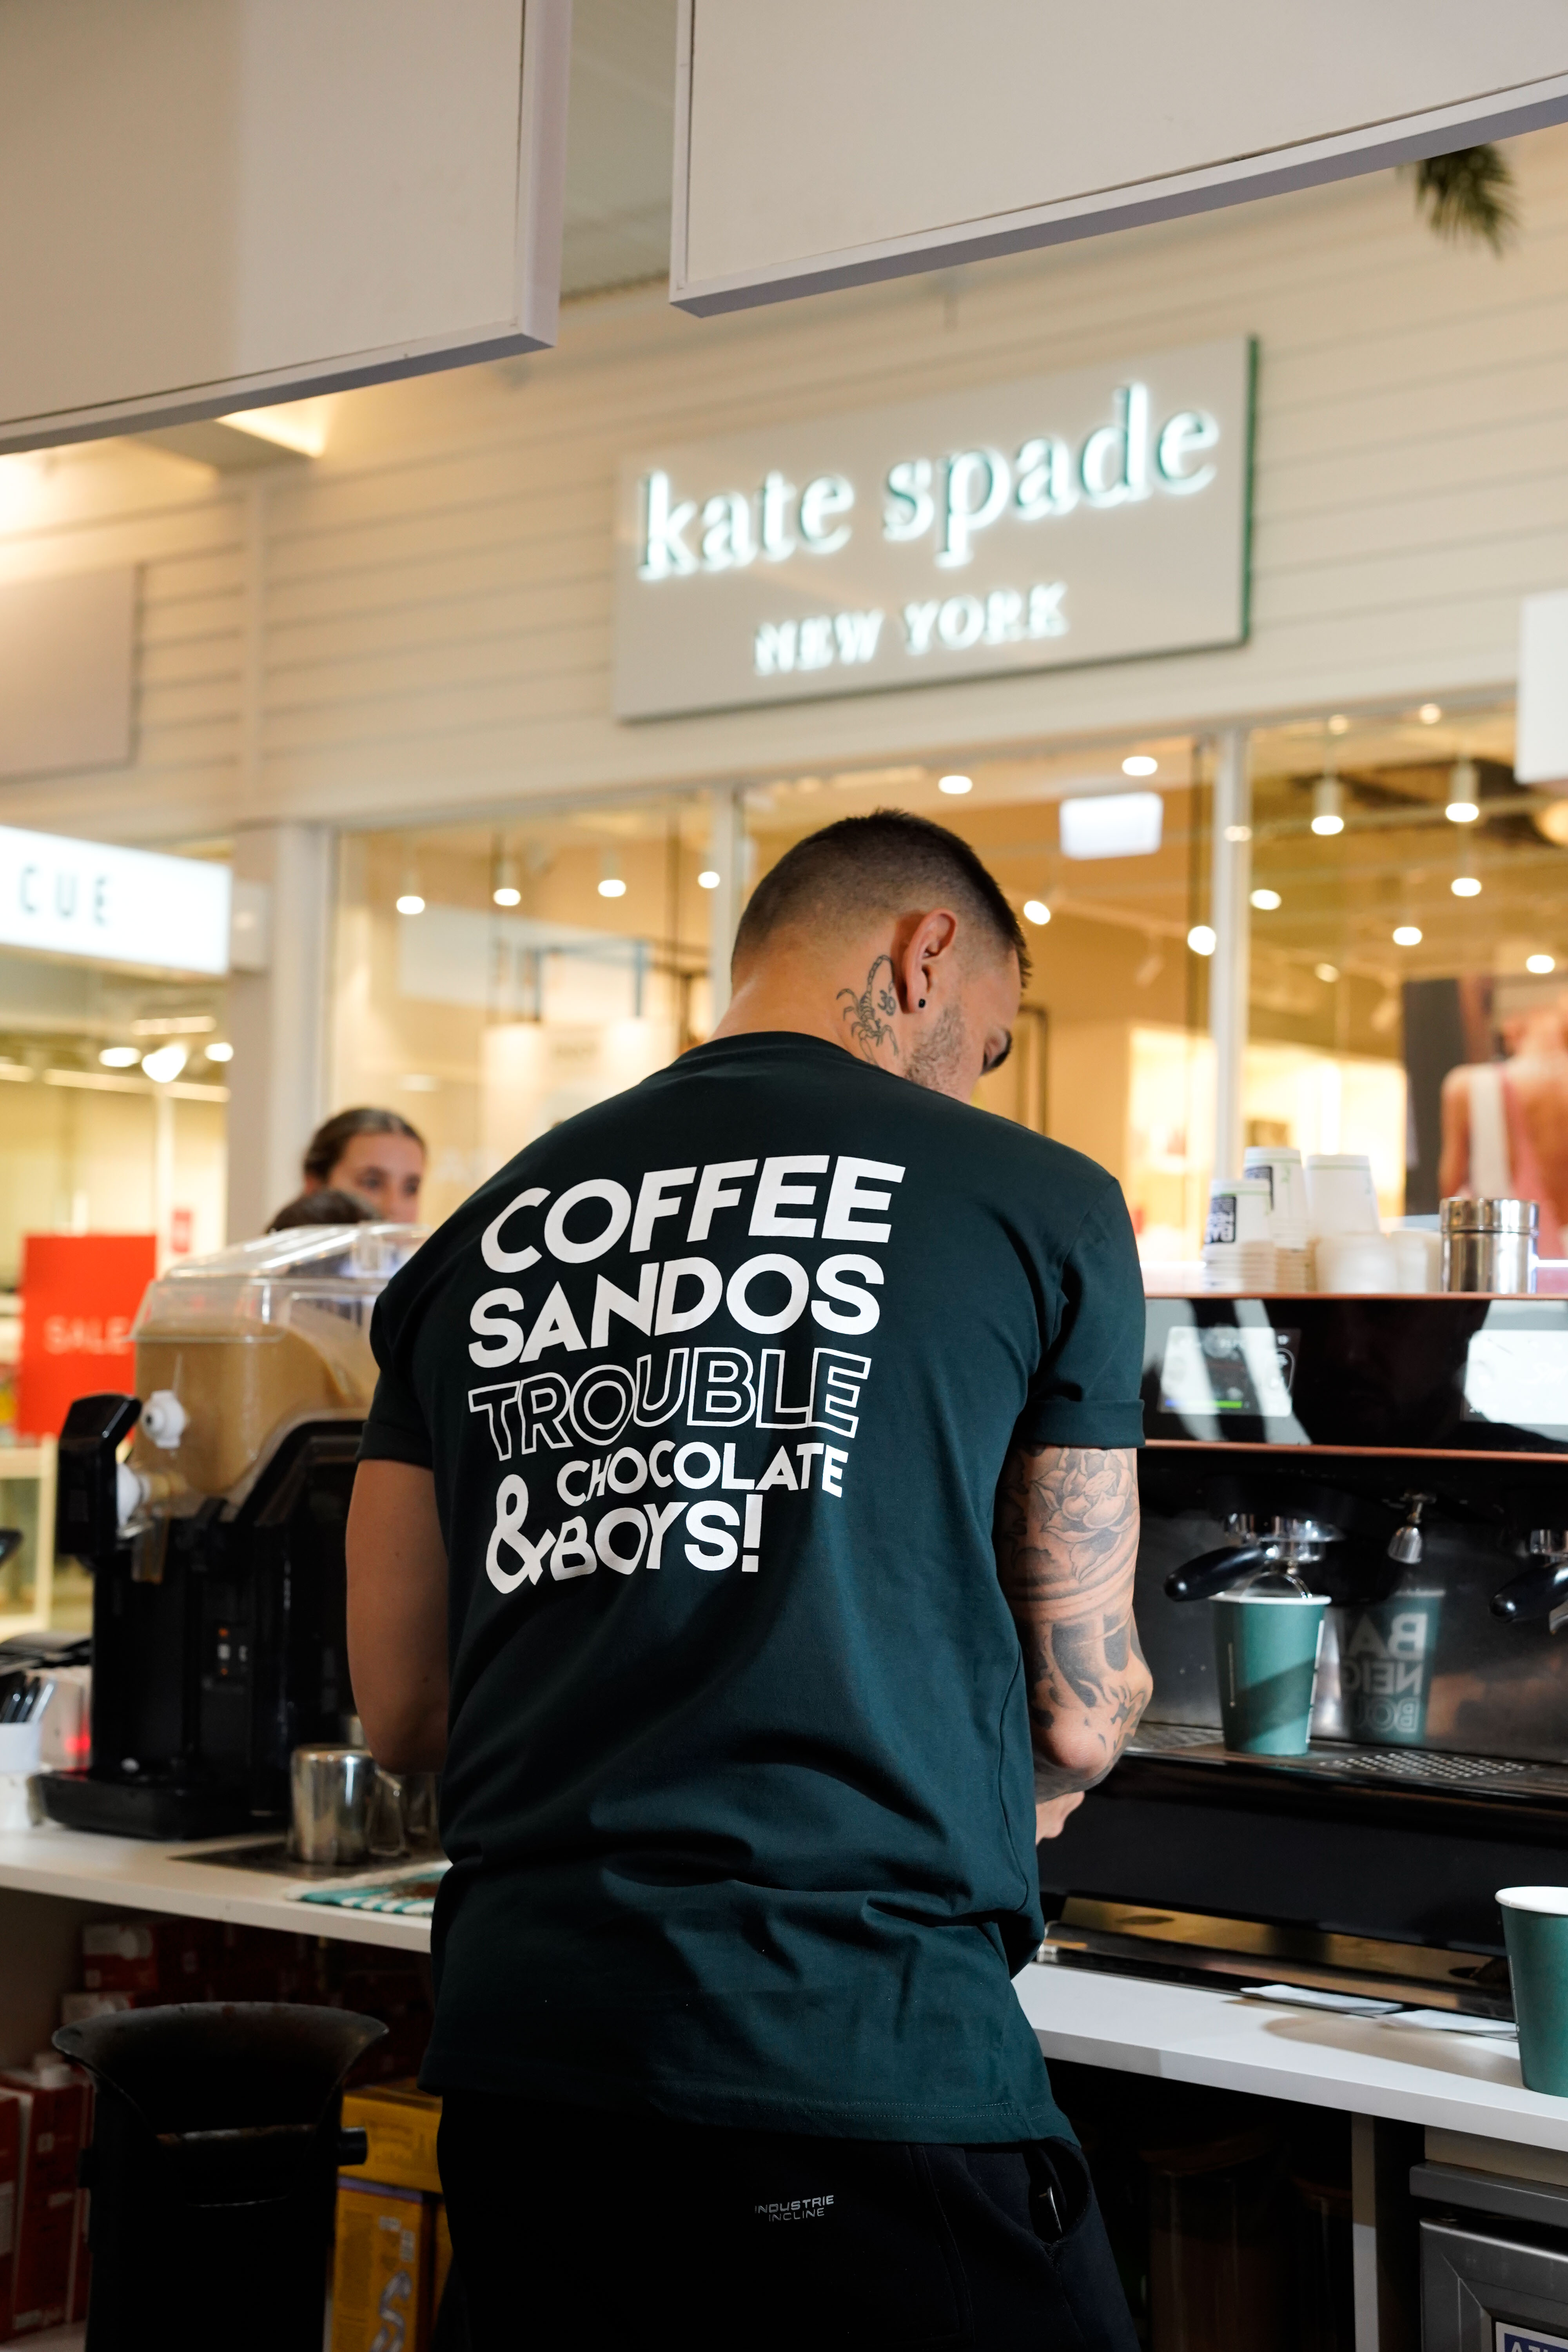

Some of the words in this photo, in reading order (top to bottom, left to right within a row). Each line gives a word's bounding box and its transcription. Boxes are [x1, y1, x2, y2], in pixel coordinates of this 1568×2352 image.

[639, 470, 854, 580] kate
[883, 381, 1219, 567] spade
[753, 608, 885, 675] NEW
[904, 581, 1069, 654] YORK
[19, 862, 109, 927] CUE
[481, 1155, 906, 1272] COFFEE
[44, 1315, 130, 1355] SALE
[468, 1254, 884, 1368] SANDOS
[468, 1347, 871, 1460] TROUBLE
[557, 1440, 848, 1506] CHOCOLATE
[550, 1494, 763, 1581] BOYS!
[755, 2195, 834, 2214] INDUSTRIE
[769, 2207, 825, 2222] INCLINE
